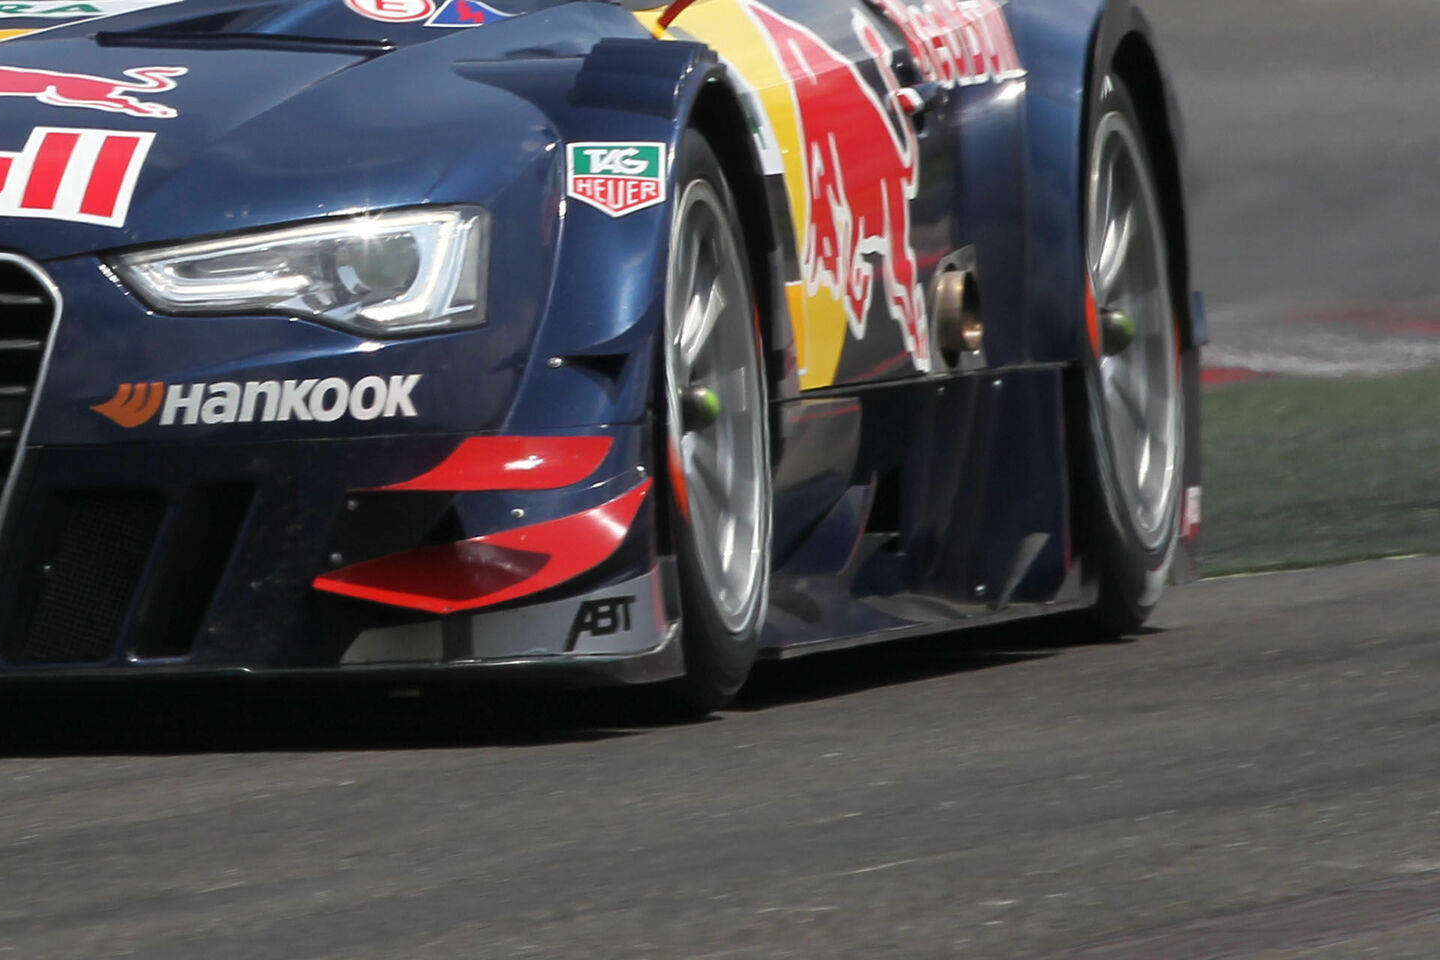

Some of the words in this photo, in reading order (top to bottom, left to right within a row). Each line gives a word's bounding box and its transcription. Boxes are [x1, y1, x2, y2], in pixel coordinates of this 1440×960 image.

[582, 146, 650, 175] TAG
[575, 178, 658, 209] HEUER
[563, 595, 637, 652] ABT
